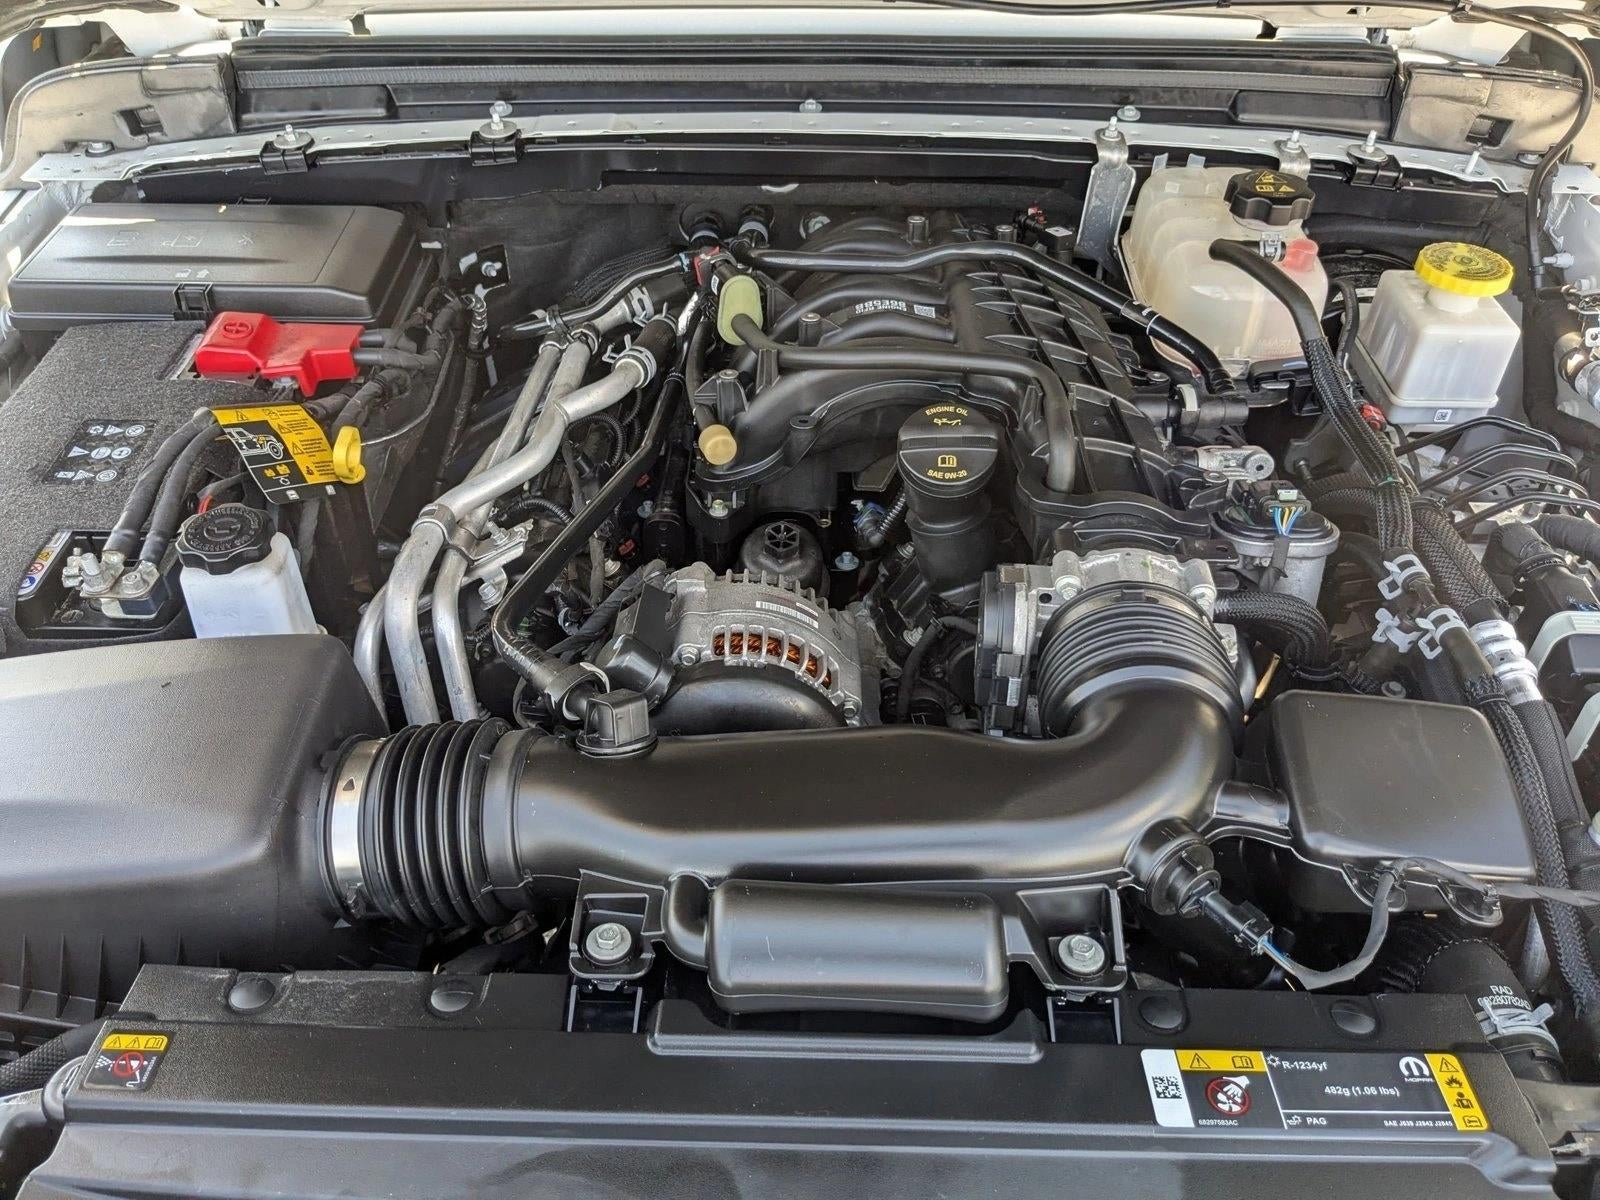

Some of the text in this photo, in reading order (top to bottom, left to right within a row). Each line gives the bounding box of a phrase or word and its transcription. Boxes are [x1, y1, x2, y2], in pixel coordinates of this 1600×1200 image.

[925, 406, 968, 416] ENGINE OIL
[927, 469, 967, 479] SAE 0W-20
[1489, 985, 1513, 995] RAD
[1282, 1060, 1328, 1072] R-1234yf
[1324, 1085, 1400, 1097] 482g (1.06 lbs)
[1306, 1117, 1327, 1126] PAG
